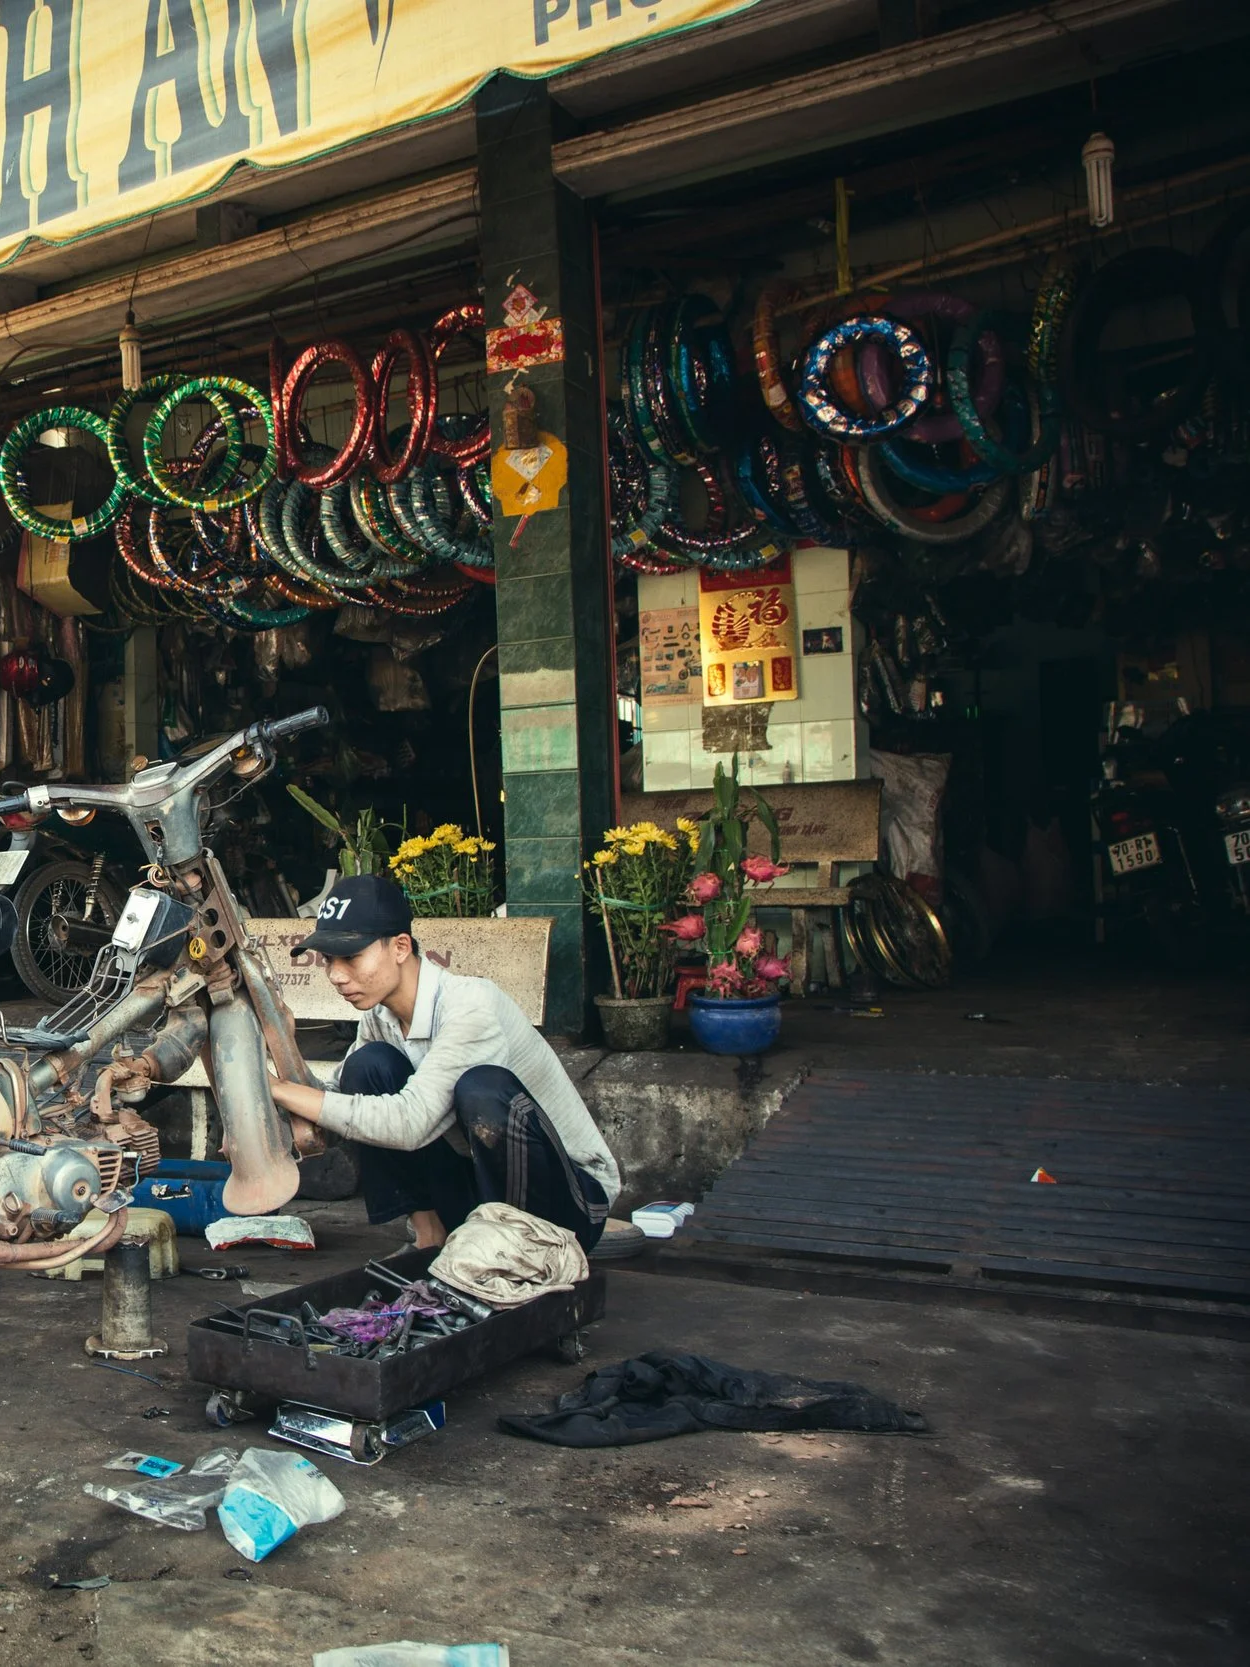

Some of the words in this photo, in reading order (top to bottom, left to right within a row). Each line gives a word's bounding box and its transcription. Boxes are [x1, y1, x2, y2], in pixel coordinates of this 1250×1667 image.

[119, 0, 311, 195] AN
[747, 586, 790, 629] 福
[1117, 850, 1153, 871] 1590
